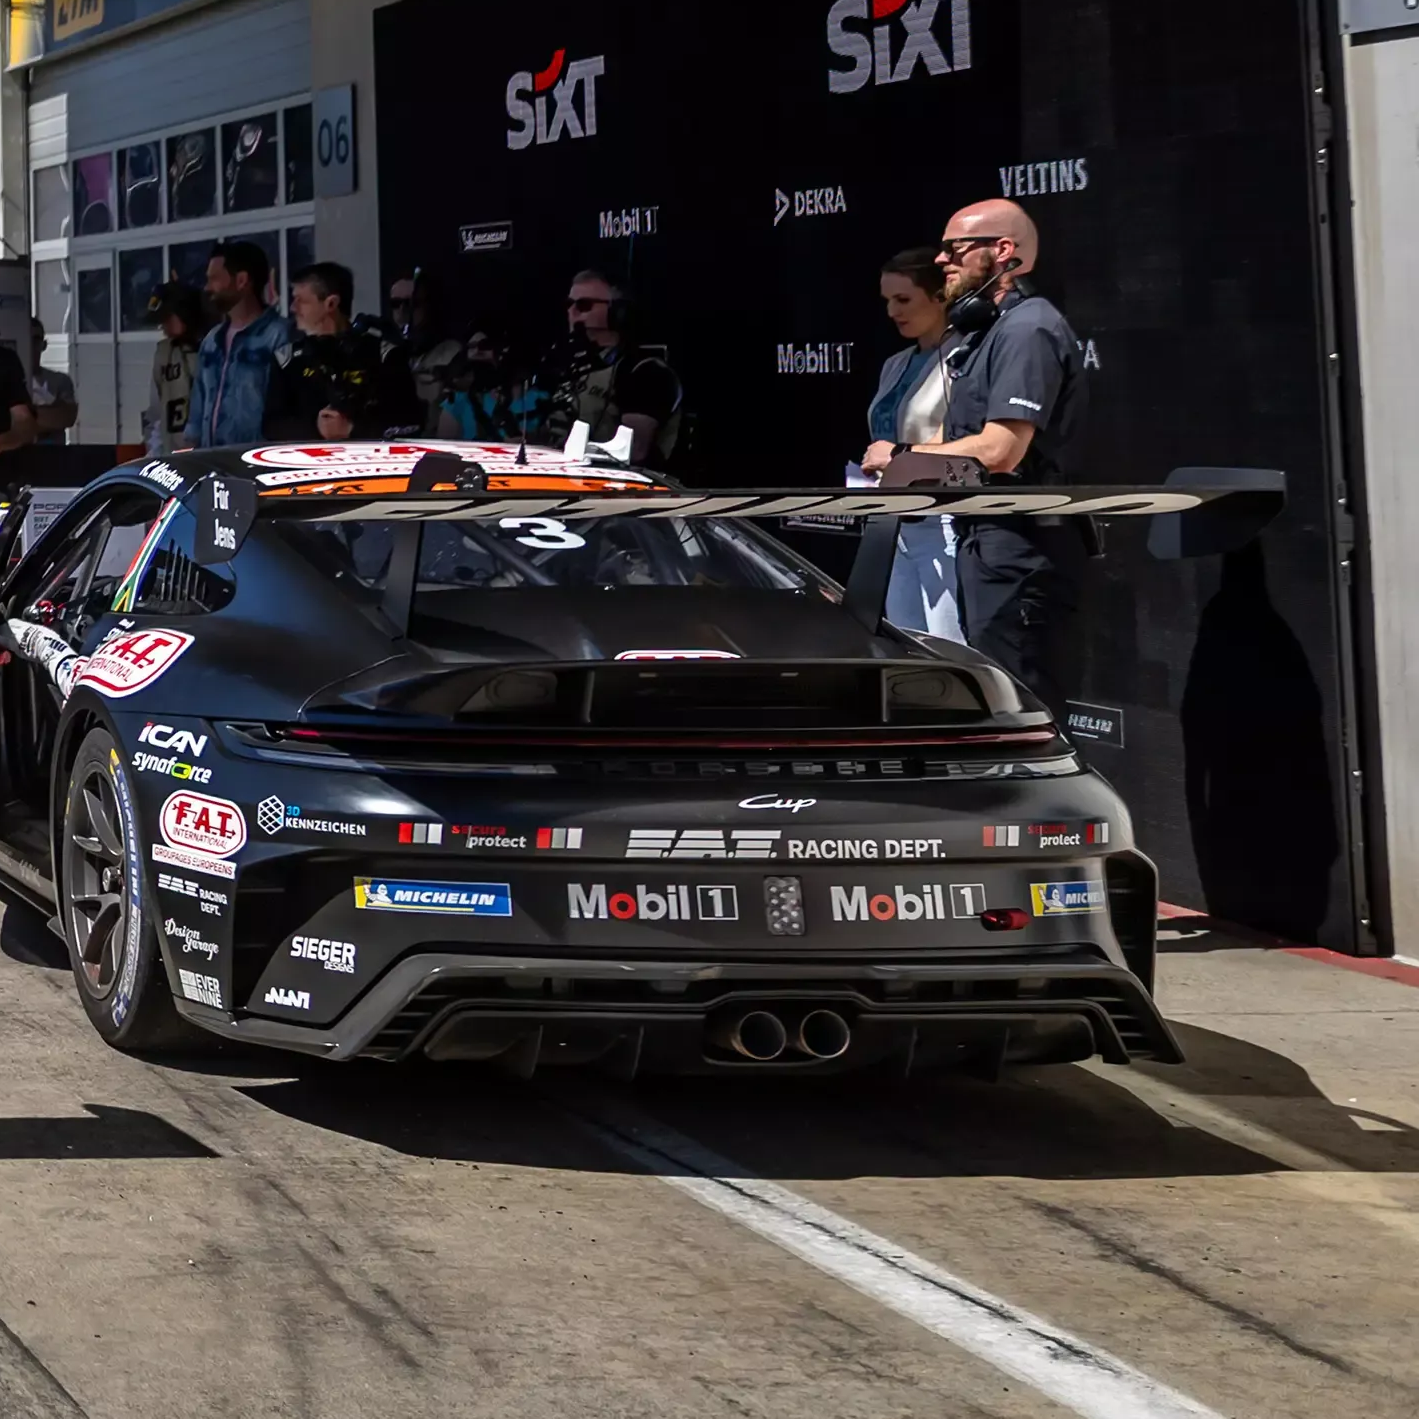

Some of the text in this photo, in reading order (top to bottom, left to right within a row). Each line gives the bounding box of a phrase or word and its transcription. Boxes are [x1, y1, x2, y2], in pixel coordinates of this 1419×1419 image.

[317, 114, 350, 167] 06
[999, 158, 1089, 198] VELTINS
[794, 186, 847, 218] DEKRA
[599, 207, 640, 239] Mobil
[777, 344, 829, 376] Mobil
[213, 480, 230, 511] Für
[213, 518, 236, 550] Jens
[498, 517, 587, 550] 3
[131, 752, 212, 784] synaforce
[286, 805, 301, 818] 3D
[738, 793, 817, 813] Cup
[172, 826, 229, 850] INTERNATIONAL
[285, 817, 367, 837] KENNZEICHEN
[466, 833, 528, 850] protect
[788, 838, 879, 860] RACING
[885, 838, 947, 860] DEPT.
[1039, 832, 1081, 848] protect
[153, 845, 192, 867] GROUPAGES
[199, 888, 228, 906] RACING
[200, 901, 222, 917] DEPT.
[393, 889, 496, 906] MICHELIN
[567, 883, 691, 921] Mobil
[830, 884, 946, 923] Mobil
[164, 917, 201, 943] Design
[290, 935, 356, 965] SIEGER
[323, 960, 355, 974] DESIGNS
[196, 971, 220, 993] EVER
[198, 987, 223, 1009] NINE
